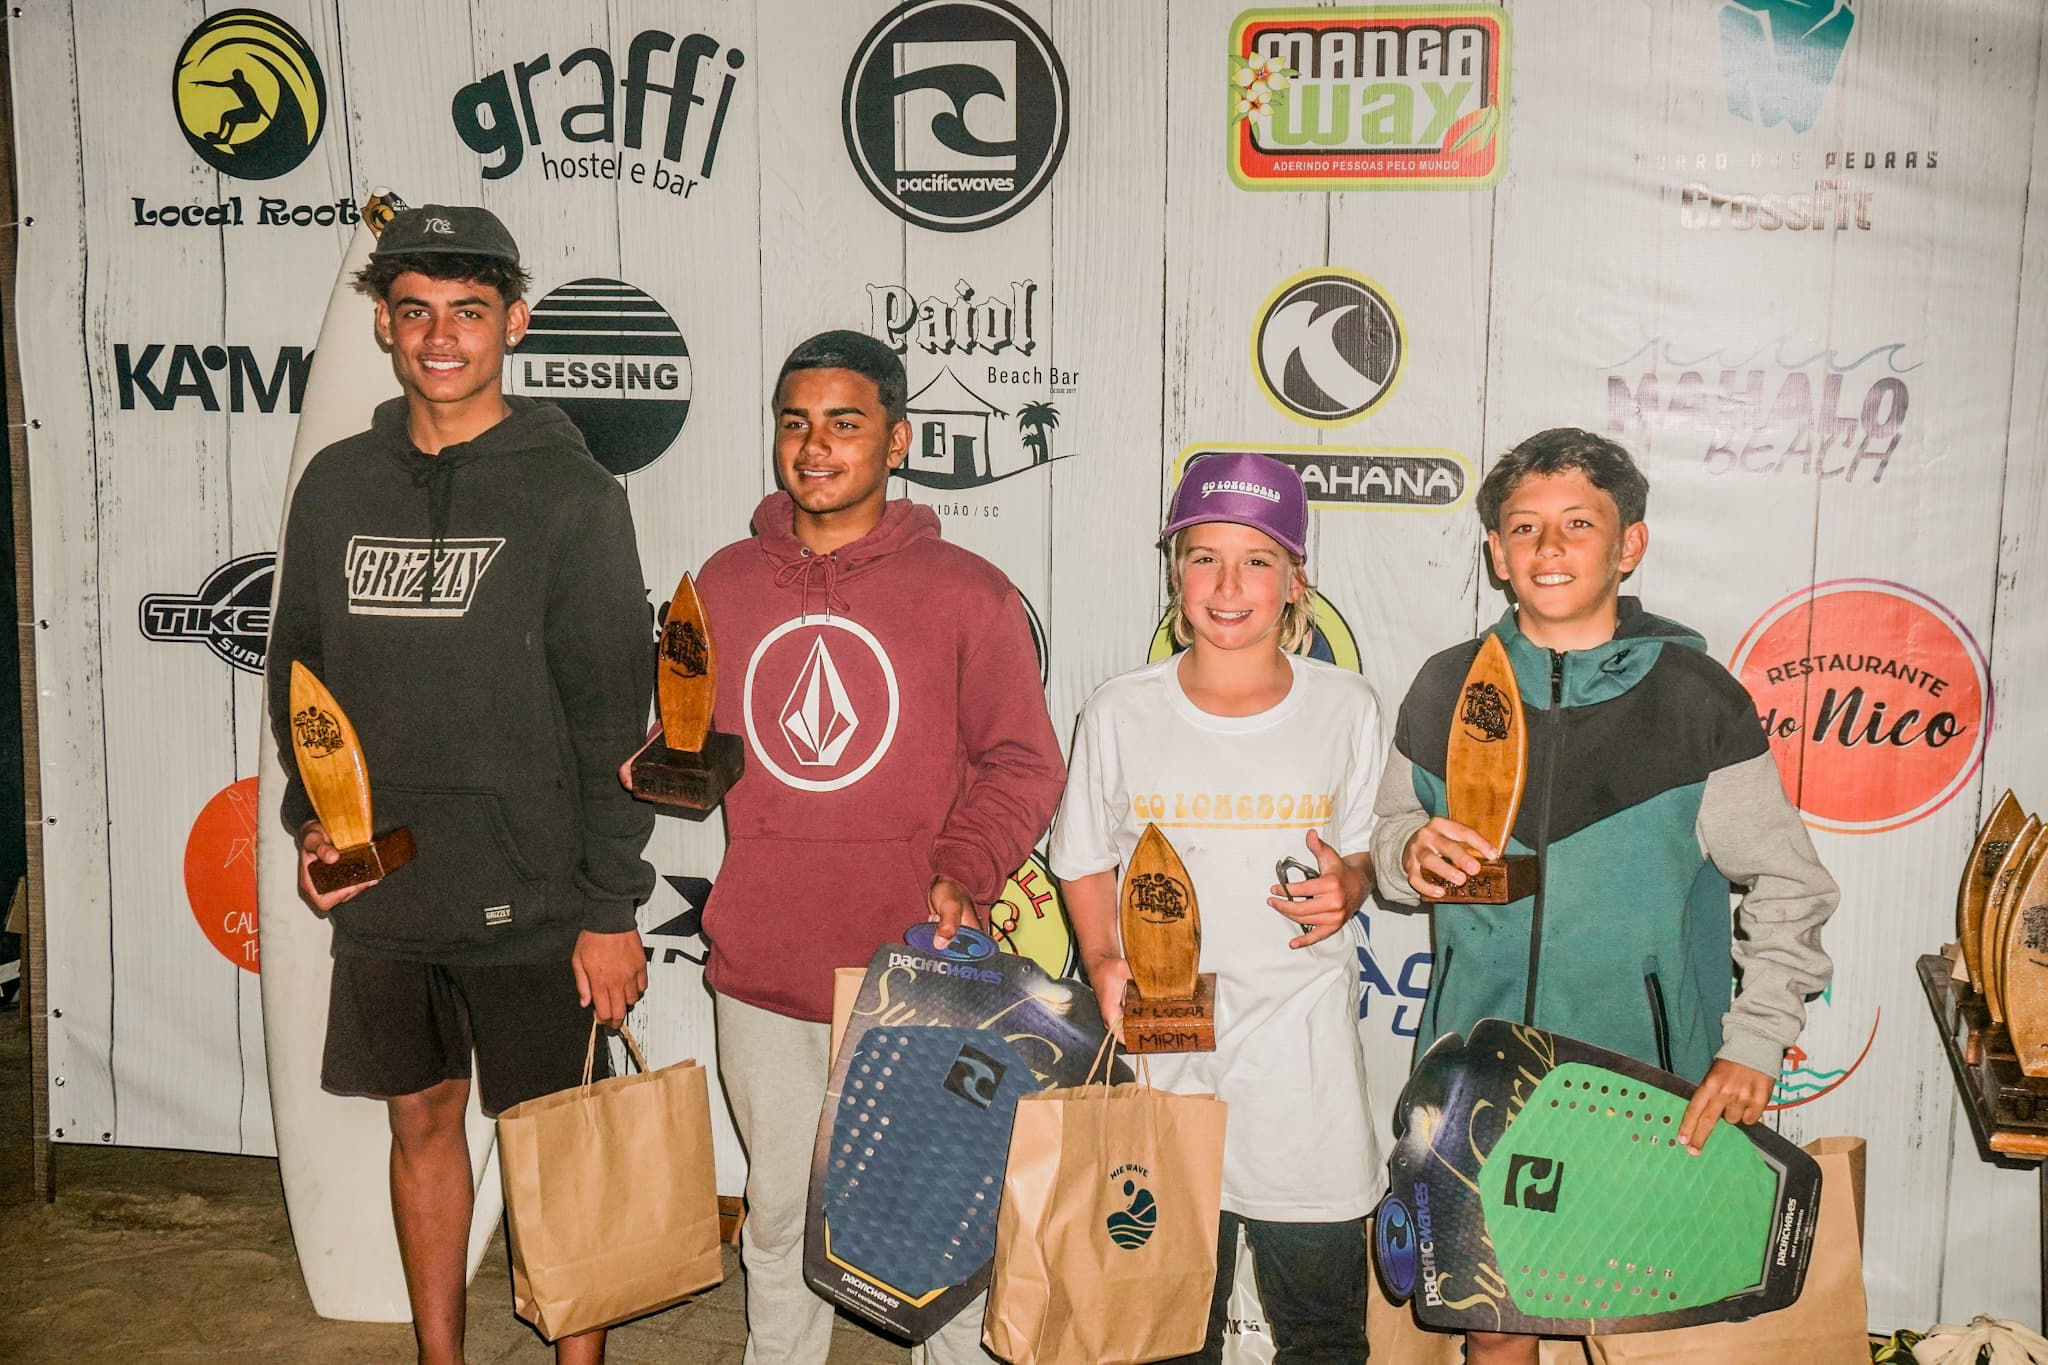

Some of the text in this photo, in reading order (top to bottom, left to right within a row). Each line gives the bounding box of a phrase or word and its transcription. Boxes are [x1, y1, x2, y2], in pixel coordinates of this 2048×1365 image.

[452, 30, 745, 179] graffi
[541, 152, 698, 199] hostel e bar
[1273, 160, 1460, 171] ADERINDO PESSOAS PELO MUNDO
[1825, 151, 1938, 169] PEDRAS
[896, 173, 1015, 196] pacificwaves
[131, 196, 244, 227] Local
[865, 278, 1038, 357] Paiol
[524, 360, 679, 391] LESSING
[988, 366, 1079, 385] Beach Bar
[1607, 370, 1910, 439] MAHALO
[1704, 427, 1902, 483] BEACH
[983, 506, 999, 518] SC
[1766, 653, 1950, 698] RESTAURANTE
[1812, 686, 1968, 749] Nico
[888, 952, 1004, 985] pacificwaves
[1153, 1005, 1205, 1018] LUGAR
[1414, 1181, 1443, 1308] pacificwaves
